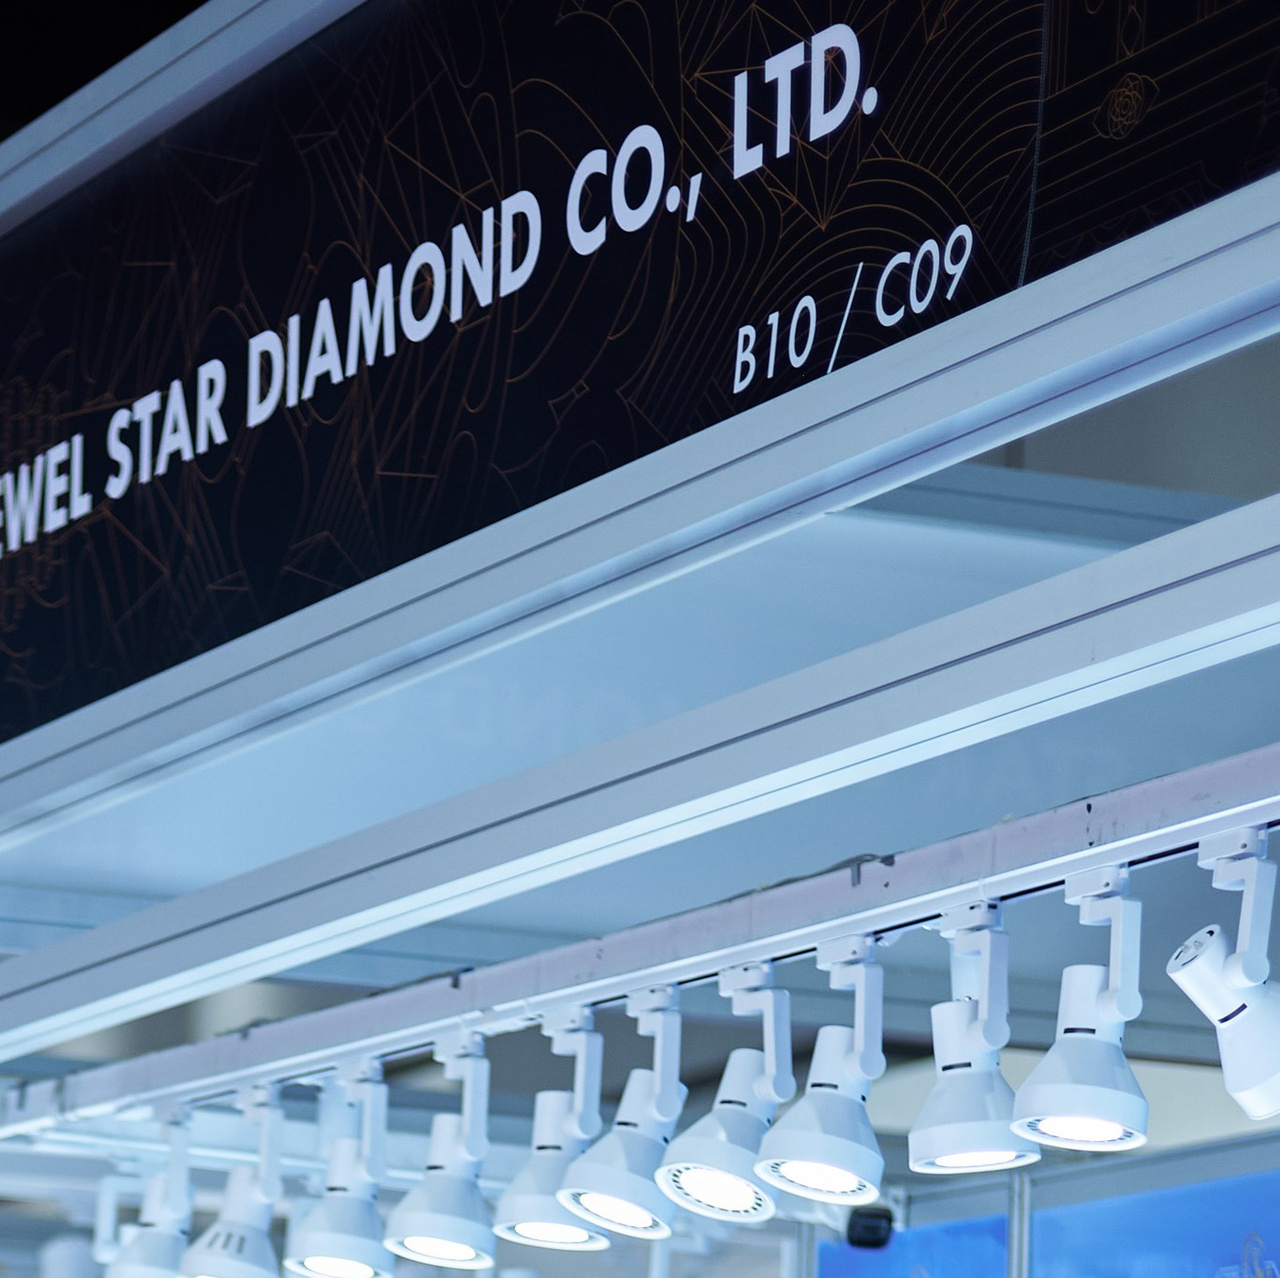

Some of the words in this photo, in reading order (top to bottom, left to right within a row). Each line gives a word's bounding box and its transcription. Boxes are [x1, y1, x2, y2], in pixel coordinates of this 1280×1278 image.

[104, 358, 229, 500] STAR
[246, 189, 543, 429] DIAMOND
[565, 123, 703, 257] CO.,
[732, 22, 878, 181] LTD.
[732, 294, 818, 395] B10
[874, 223, 974, 328] C09
